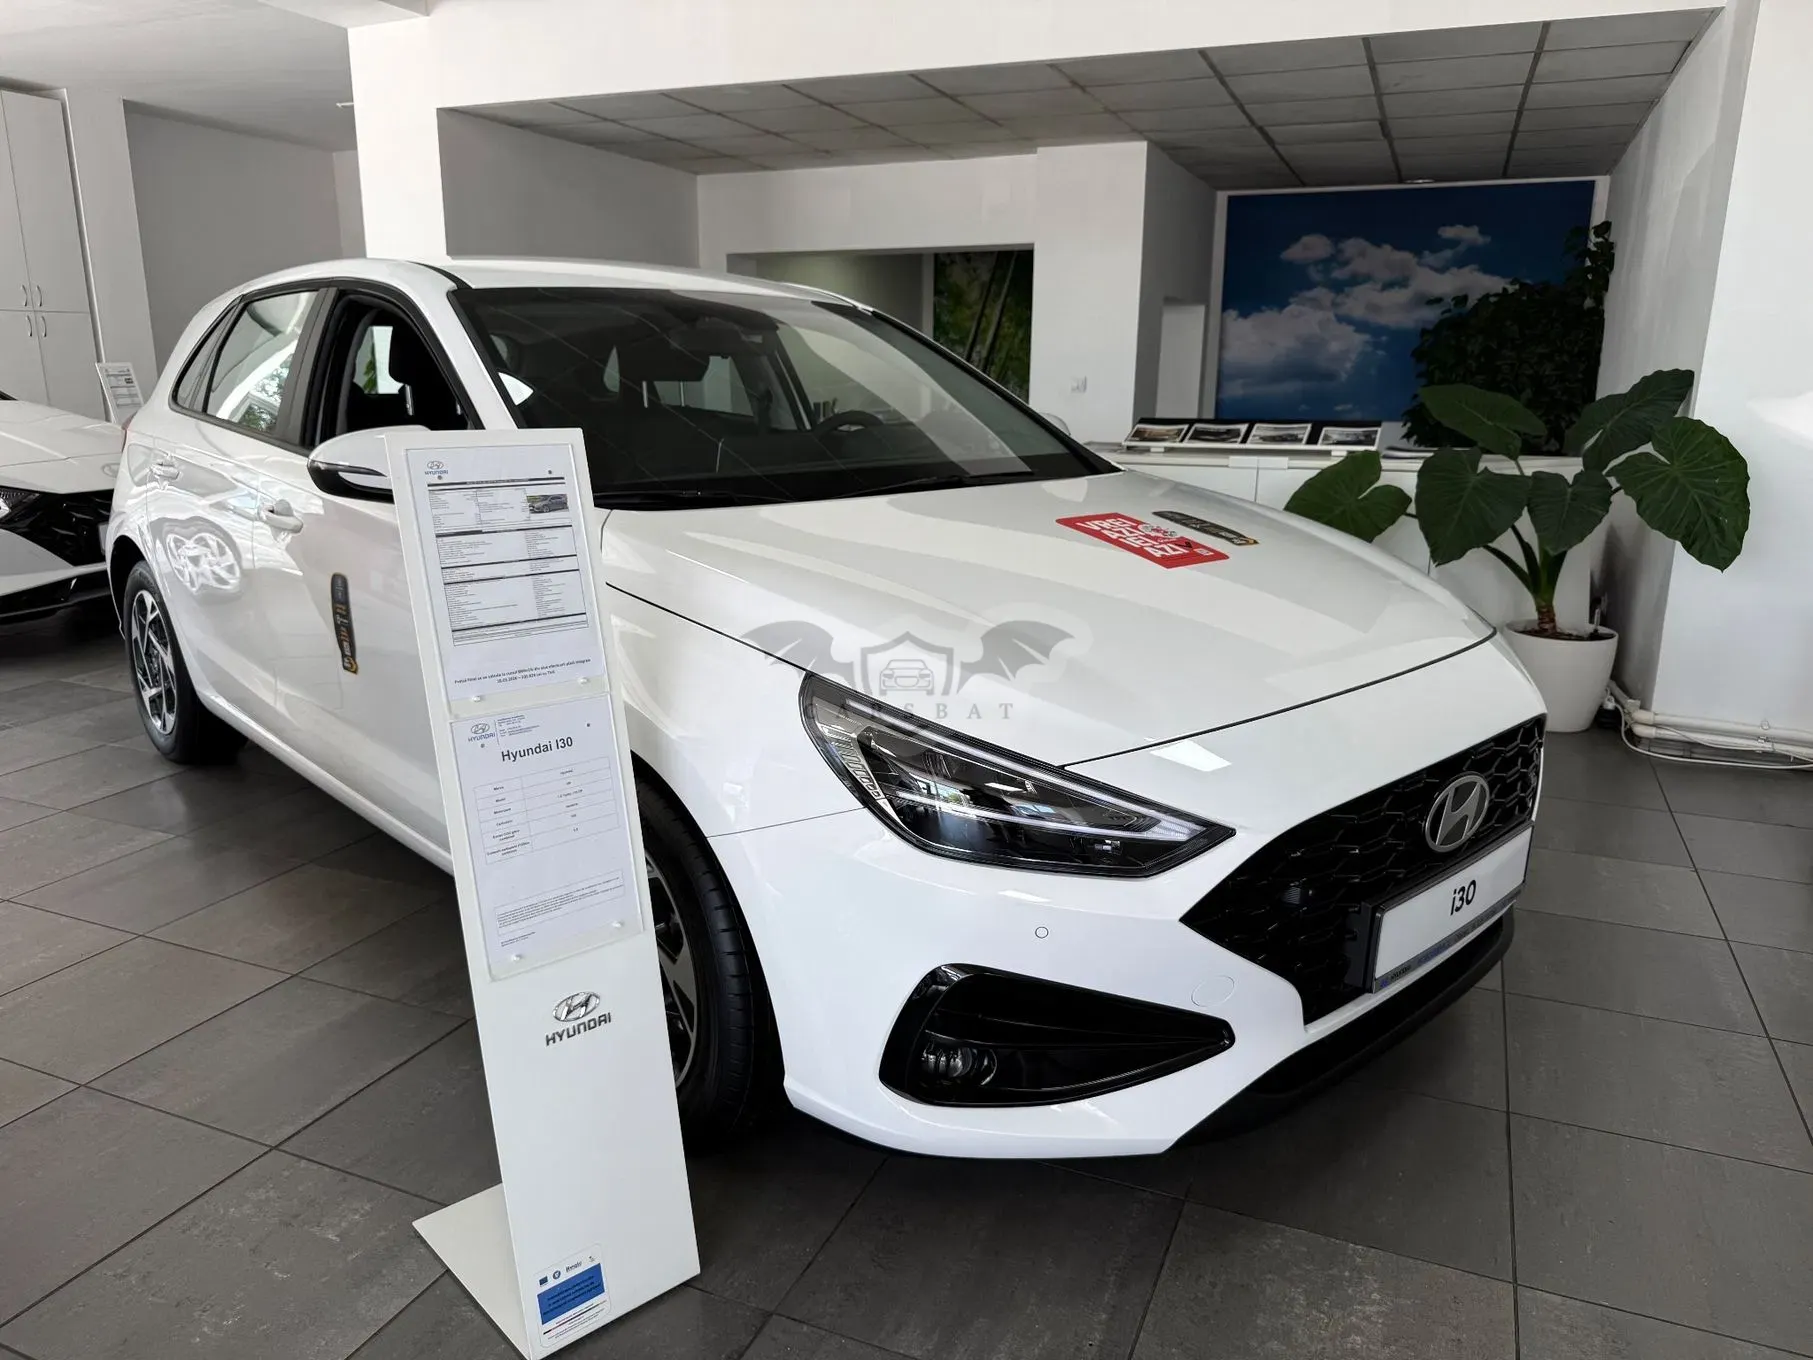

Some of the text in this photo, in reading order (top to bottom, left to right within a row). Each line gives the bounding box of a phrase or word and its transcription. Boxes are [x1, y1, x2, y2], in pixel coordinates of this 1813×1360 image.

[1076, 518, 1139, 531] VREI
[1100, 525, 1142, 539] AZI
[1118, 535, 1160, 548] IEI
[1147, 543, 1191, 558] AZI
[468, 732, 496, 743] HYUNDAI
[501, 736, 573, 762] Hyundai I30
[1450, 879, 1477, 916] i30
[545, 1012, 612, 1047] HYUNDAI
